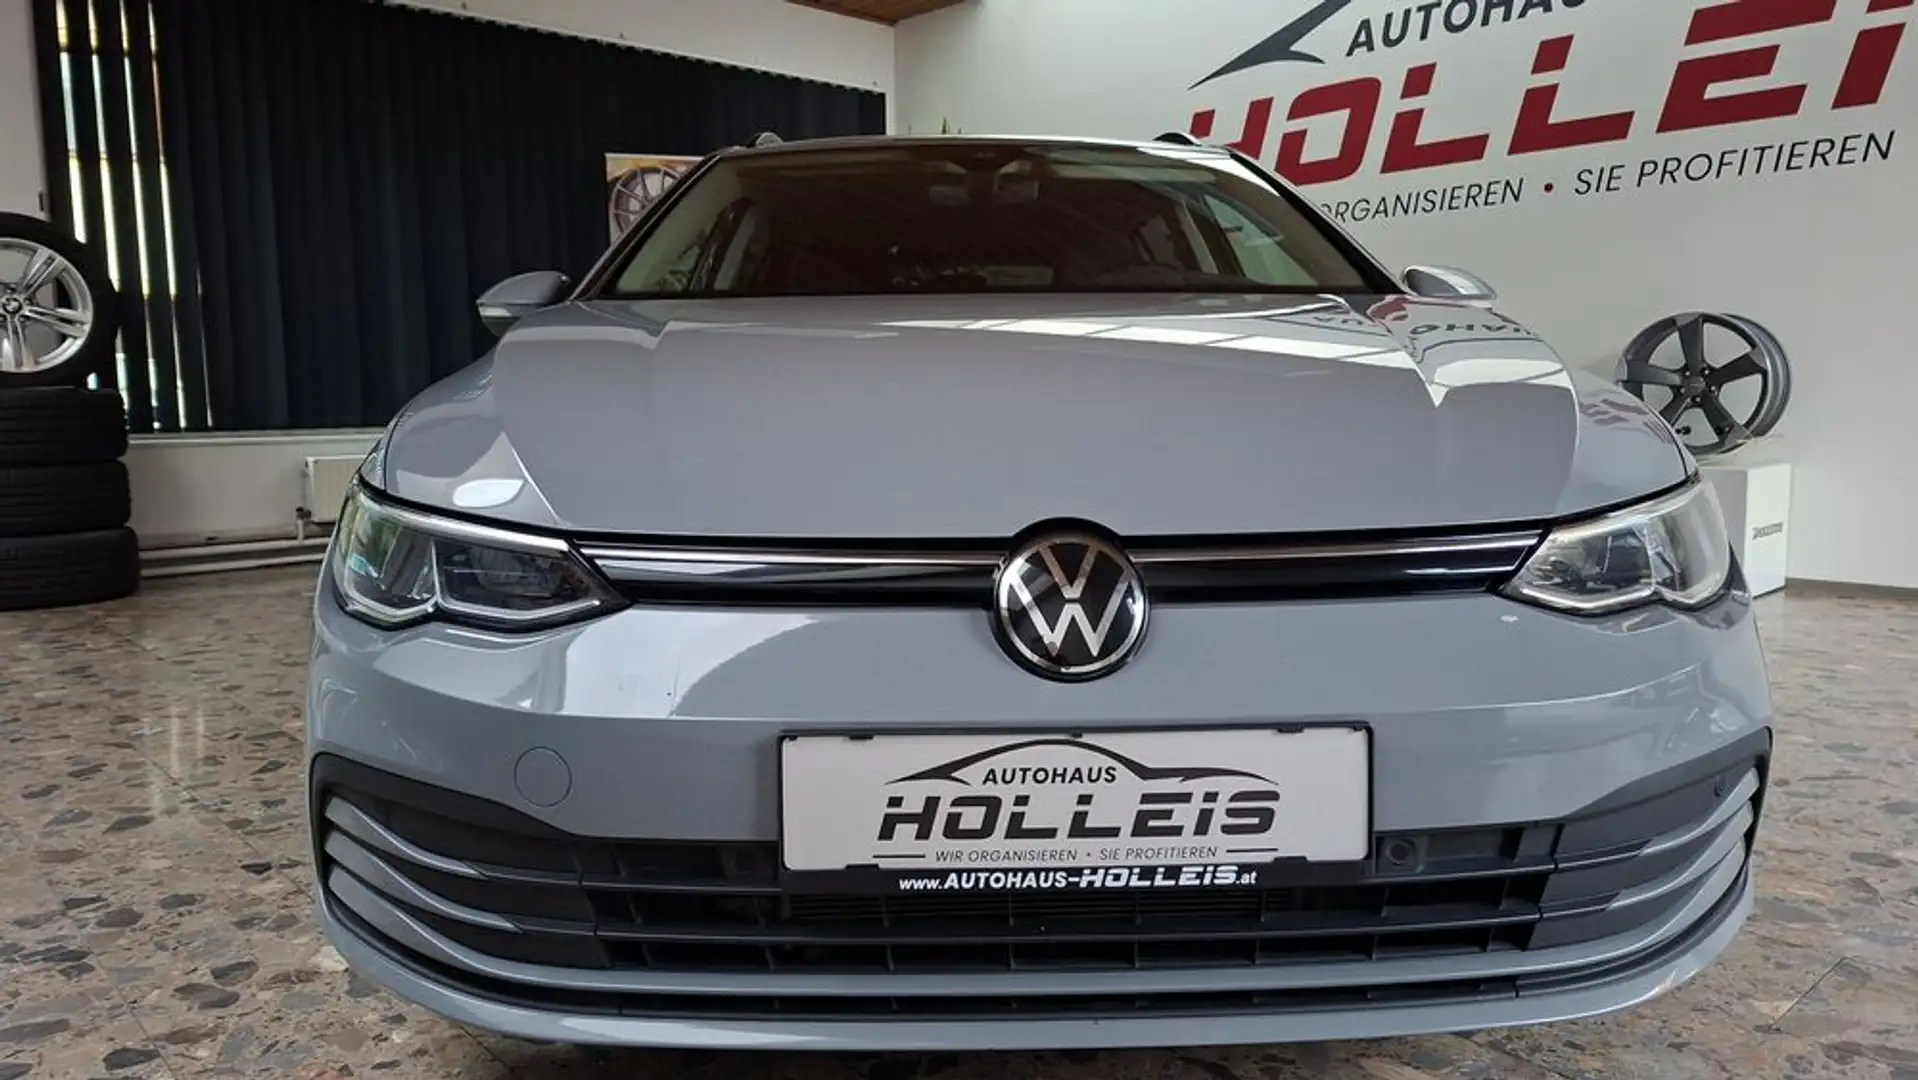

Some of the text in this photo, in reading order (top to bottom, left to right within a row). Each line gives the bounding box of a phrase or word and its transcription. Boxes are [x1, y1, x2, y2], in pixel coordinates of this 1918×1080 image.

[1574, 163, 1624, 196] SIE
[1636, 130, 1897, 188] PROFITIEREN
[982, 766, 1117, 786] AUTOHAUS
[877, 790, 1281, 841] HOLLEIS
[935, 846, 1218, 863] WIR ORGANISIEREN SIE PROFITIEREN
[899, 865, 1258, 890] www.AUTOHAUS-HOLLEIS.at
